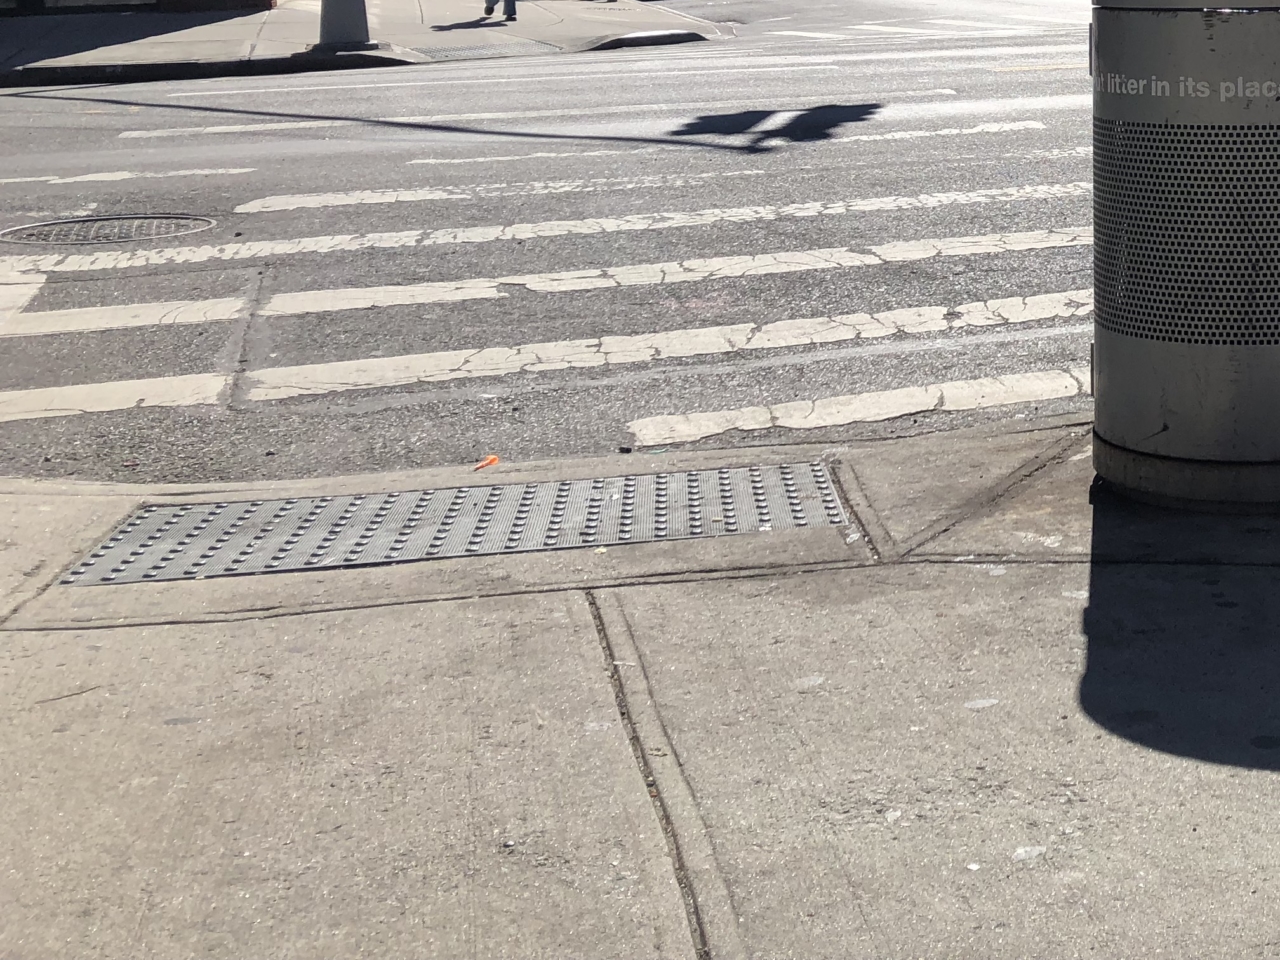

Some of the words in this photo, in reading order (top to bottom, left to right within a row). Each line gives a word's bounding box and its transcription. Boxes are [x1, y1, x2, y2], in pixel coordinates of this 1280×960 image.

[1107, 72, 1147, 95] litter
[1151, 75, 1171, 97] in
[1179, 76, 1210, 98] its
